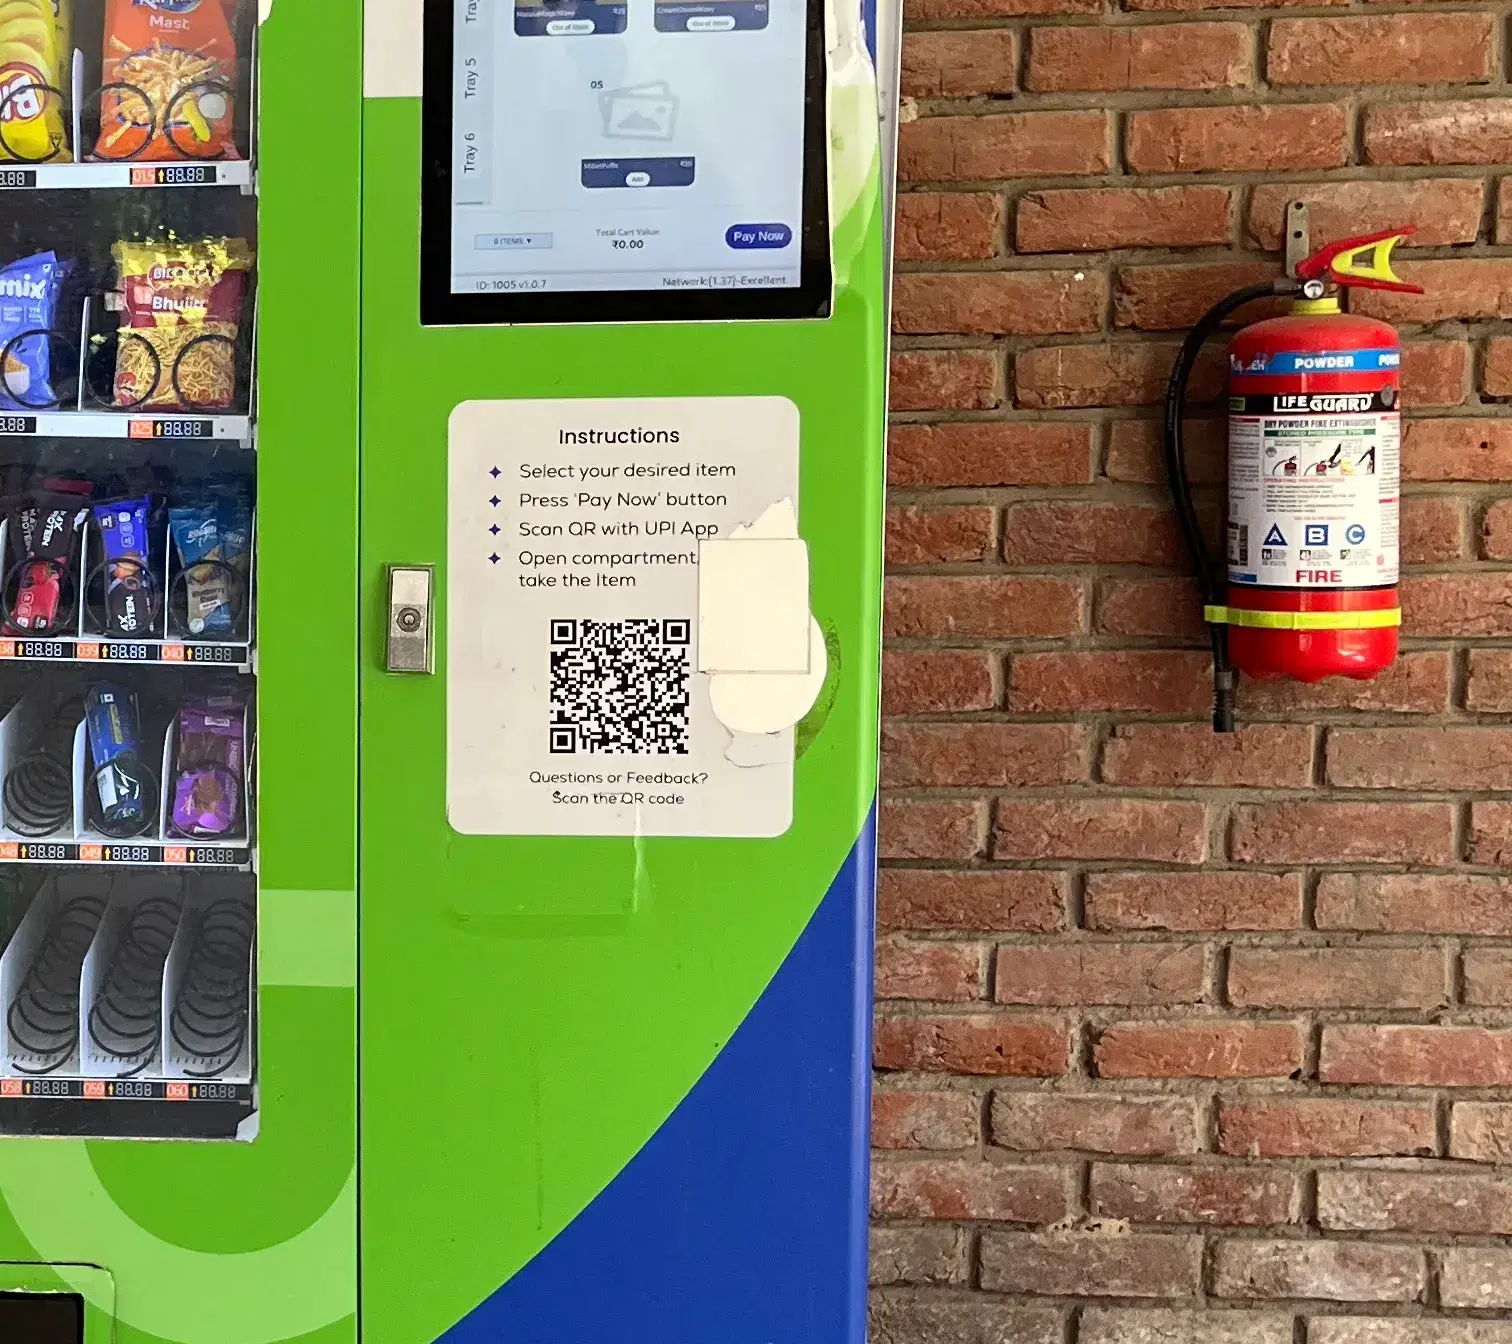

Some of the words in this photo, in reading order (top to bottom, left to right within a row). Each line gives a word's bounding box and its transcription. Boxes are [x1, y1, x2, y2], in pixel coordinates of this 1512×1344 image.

[465, 70, 479, 99] Tray
[464, 144, 478, 173] Tray
[733, 231, 755, 243] Pay
[757, 230, 784, 242] Now
[1294, 356, 1355, 369] POWDER
[559, 427, 680, 445] Instructions
[520, 464, 574, 478] Select
[579, 467, 619, 481] your
[624, 463, 690, 477] desired
[696, 463, 735, 476] item
[520, 493, 568, 507] Press
[667, 492, 726, 506] button
[519, 522, 562, 536] Scan
[569, 522, 596, 536] QR
[602, 522, 639, 535] with
[646, 521, 675, 535] UPI
[681, 521, 718, 538] App
[519, 551, 566, 569] Open
[519, 573, 556, 587] take
[562, 573, 591, 586] the
[597, 573, 636, 586] Item
[1296, 570, 1343, 583] FIRE
[529, 771, 603, 783] Questions
[607, 775, 622, 783] or
[627, 772, 708, 784] Feedback?
[553, 790, 588, 804] Scan
[592, 792, 620, 804] the
[620, 792, 644, 804] QR
[649, 793, 684, 804] code
